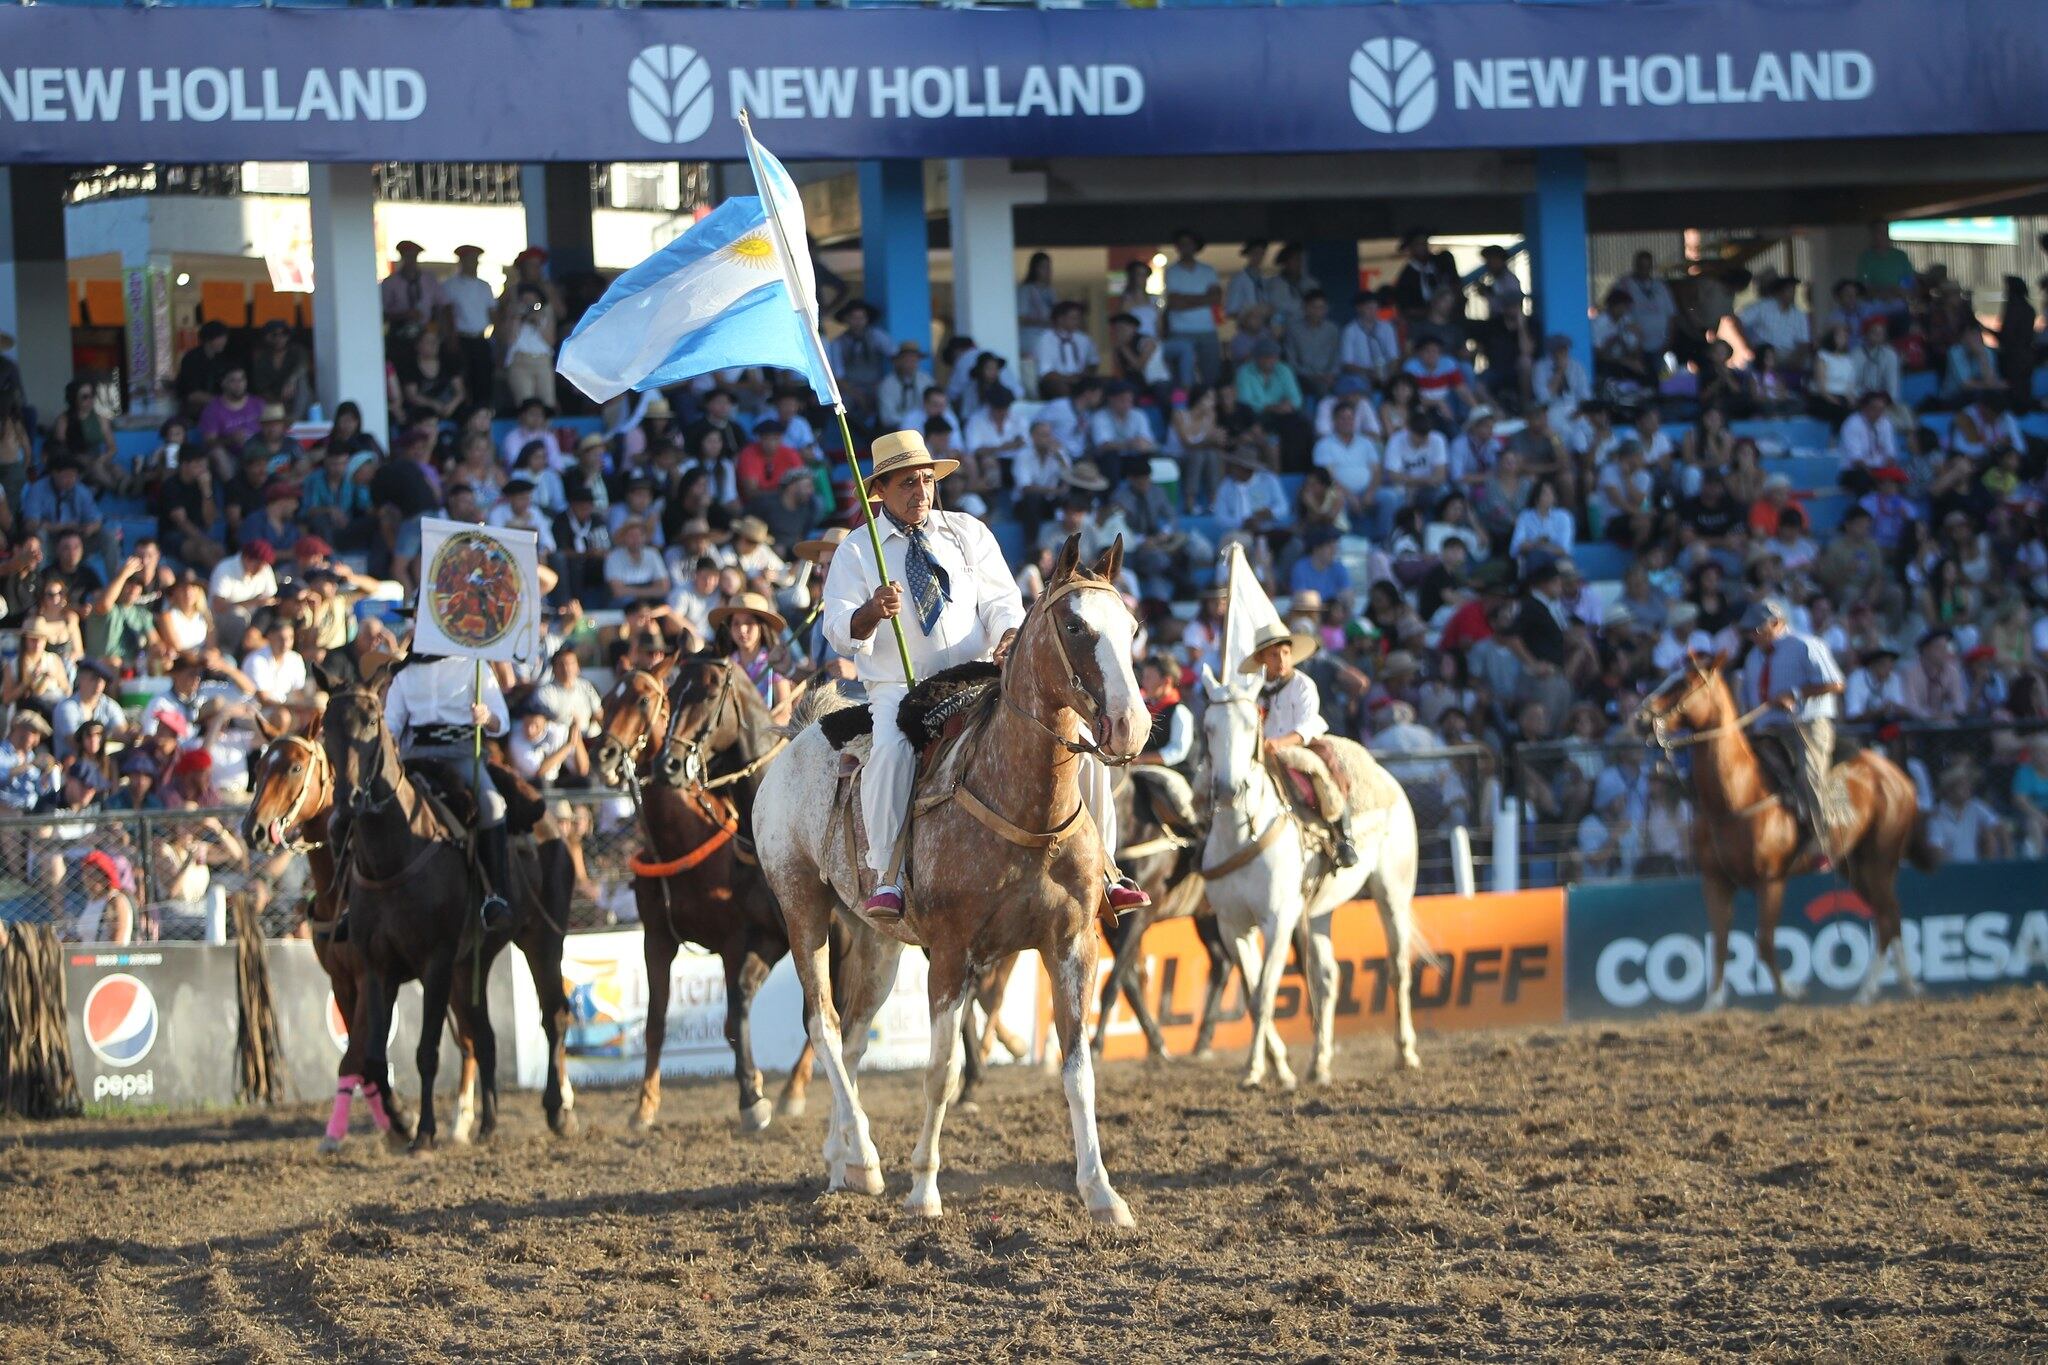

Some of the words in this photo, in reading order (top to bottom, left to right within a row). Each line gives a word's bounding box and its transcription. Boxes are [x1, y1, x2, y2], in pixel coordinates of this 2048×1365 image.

[0, 67, 125, 122] NEW
[138, 67, 428, 122] HOLLAND
[728, 66, 858, 119] NEW
[868, 64, 1145, 118] HOLLAND
[1453, 56, 1587, 110] NEW
[1598, 50, 1875, 107] HOLLAND
[93, 1068, 154, 1102] pepsi
